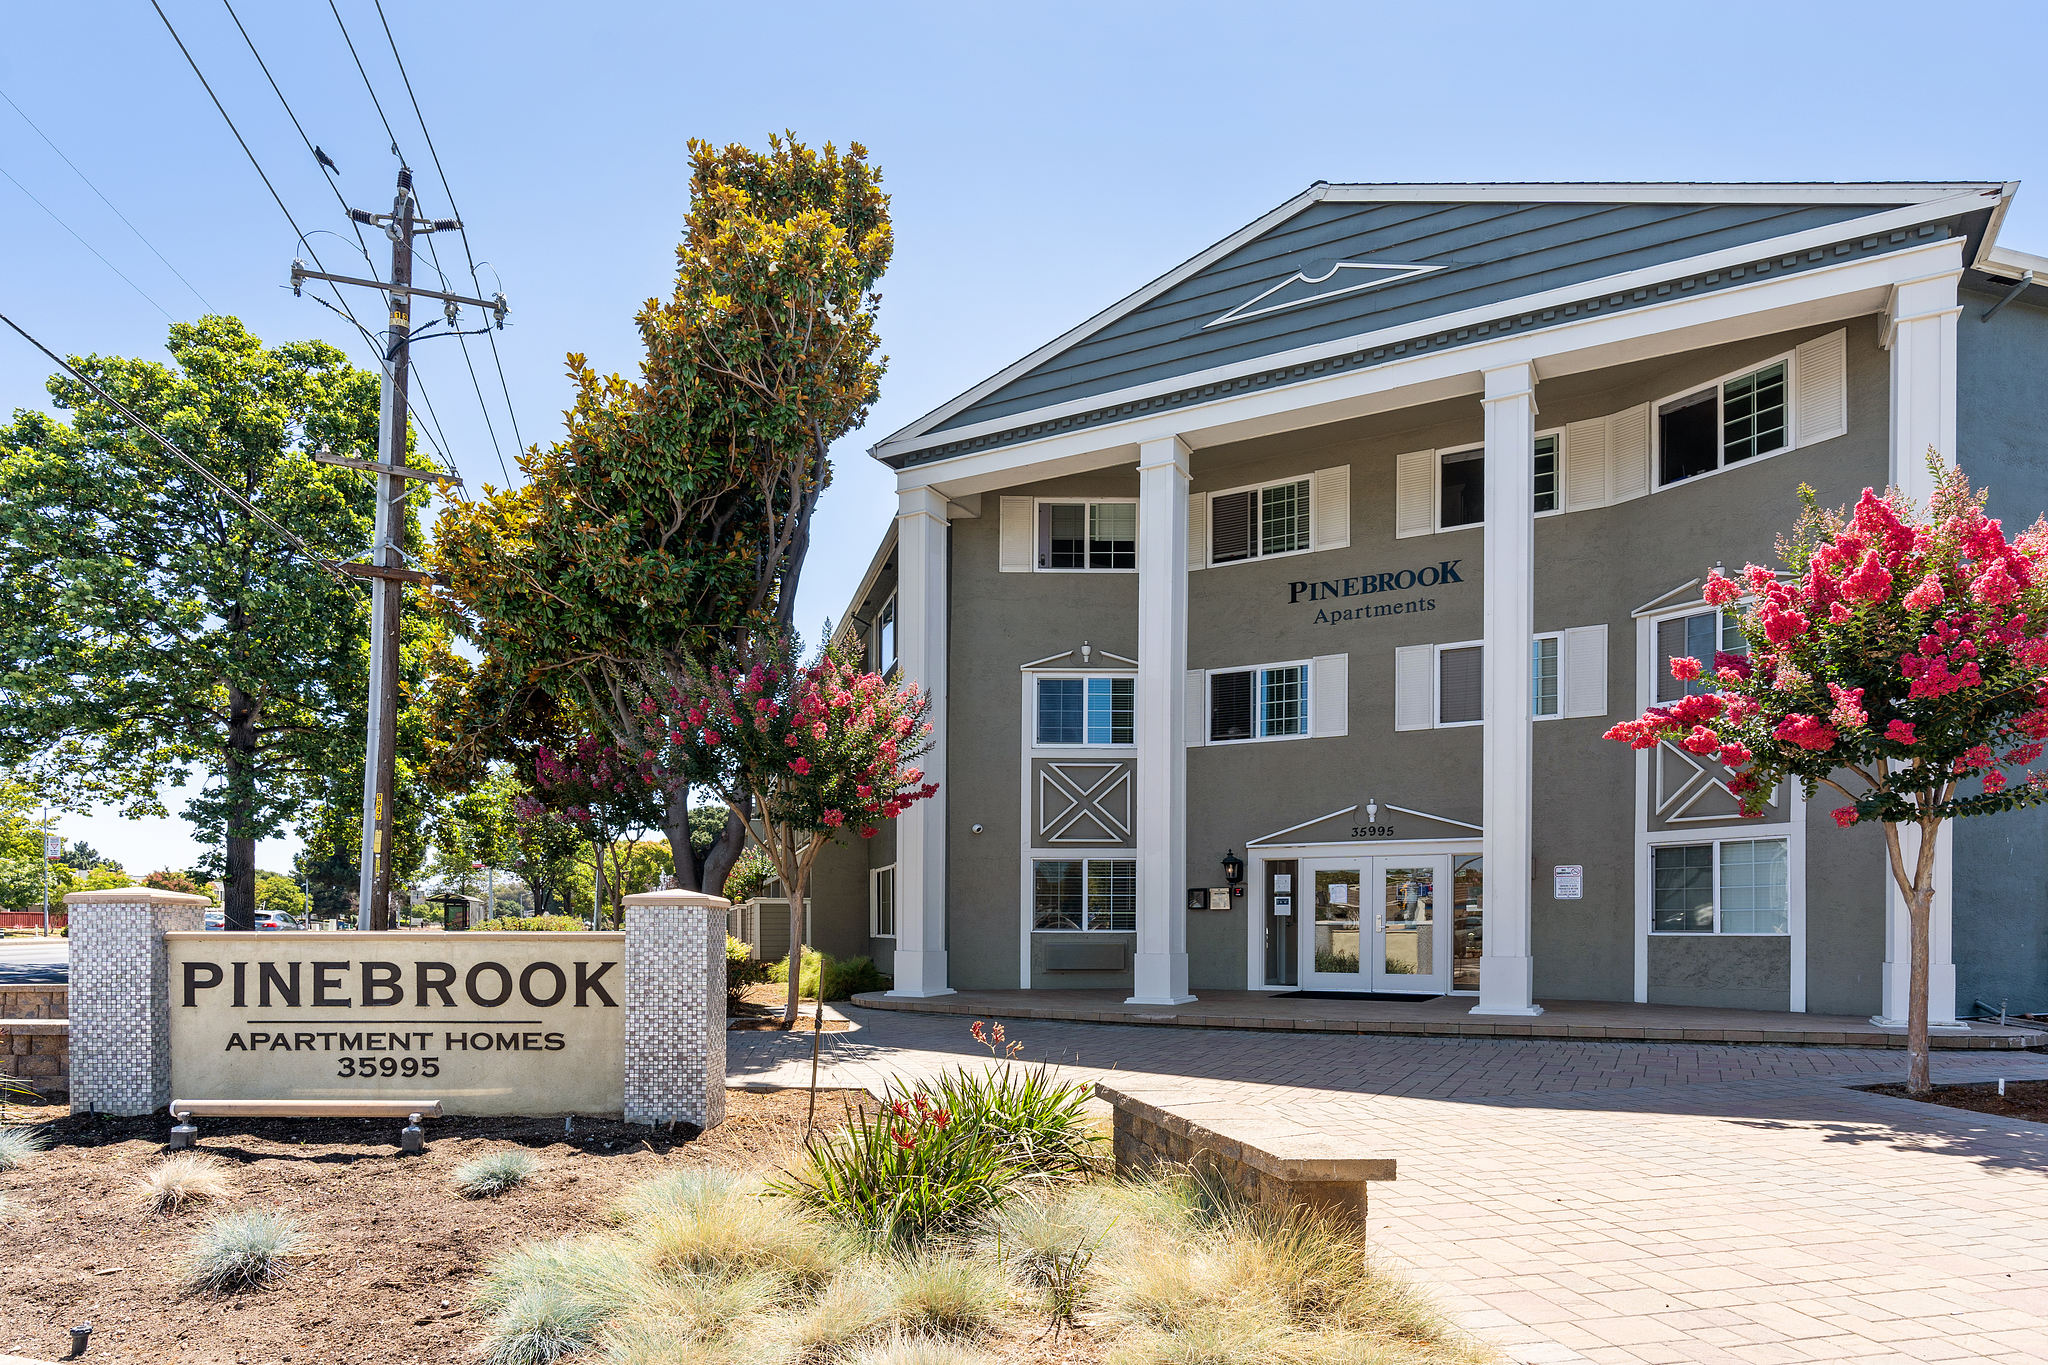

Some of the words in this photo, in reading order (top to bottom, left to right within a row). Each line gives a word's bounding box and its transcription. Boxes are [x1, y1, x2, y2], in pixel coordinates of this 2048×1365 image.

[1288, 559, 1464, 604] PINEBROOK
[1313, 598, 1436, 626] Apartments
[1351, 825, 1394, 837] 35995
[181, 960, 620, 1009] PINEBROOK
[224, 1031, 434, 1052] APARTMENT
[445, 1031, 566, 1052] HOMES
[336, 1056, 440, 1079] 35995
